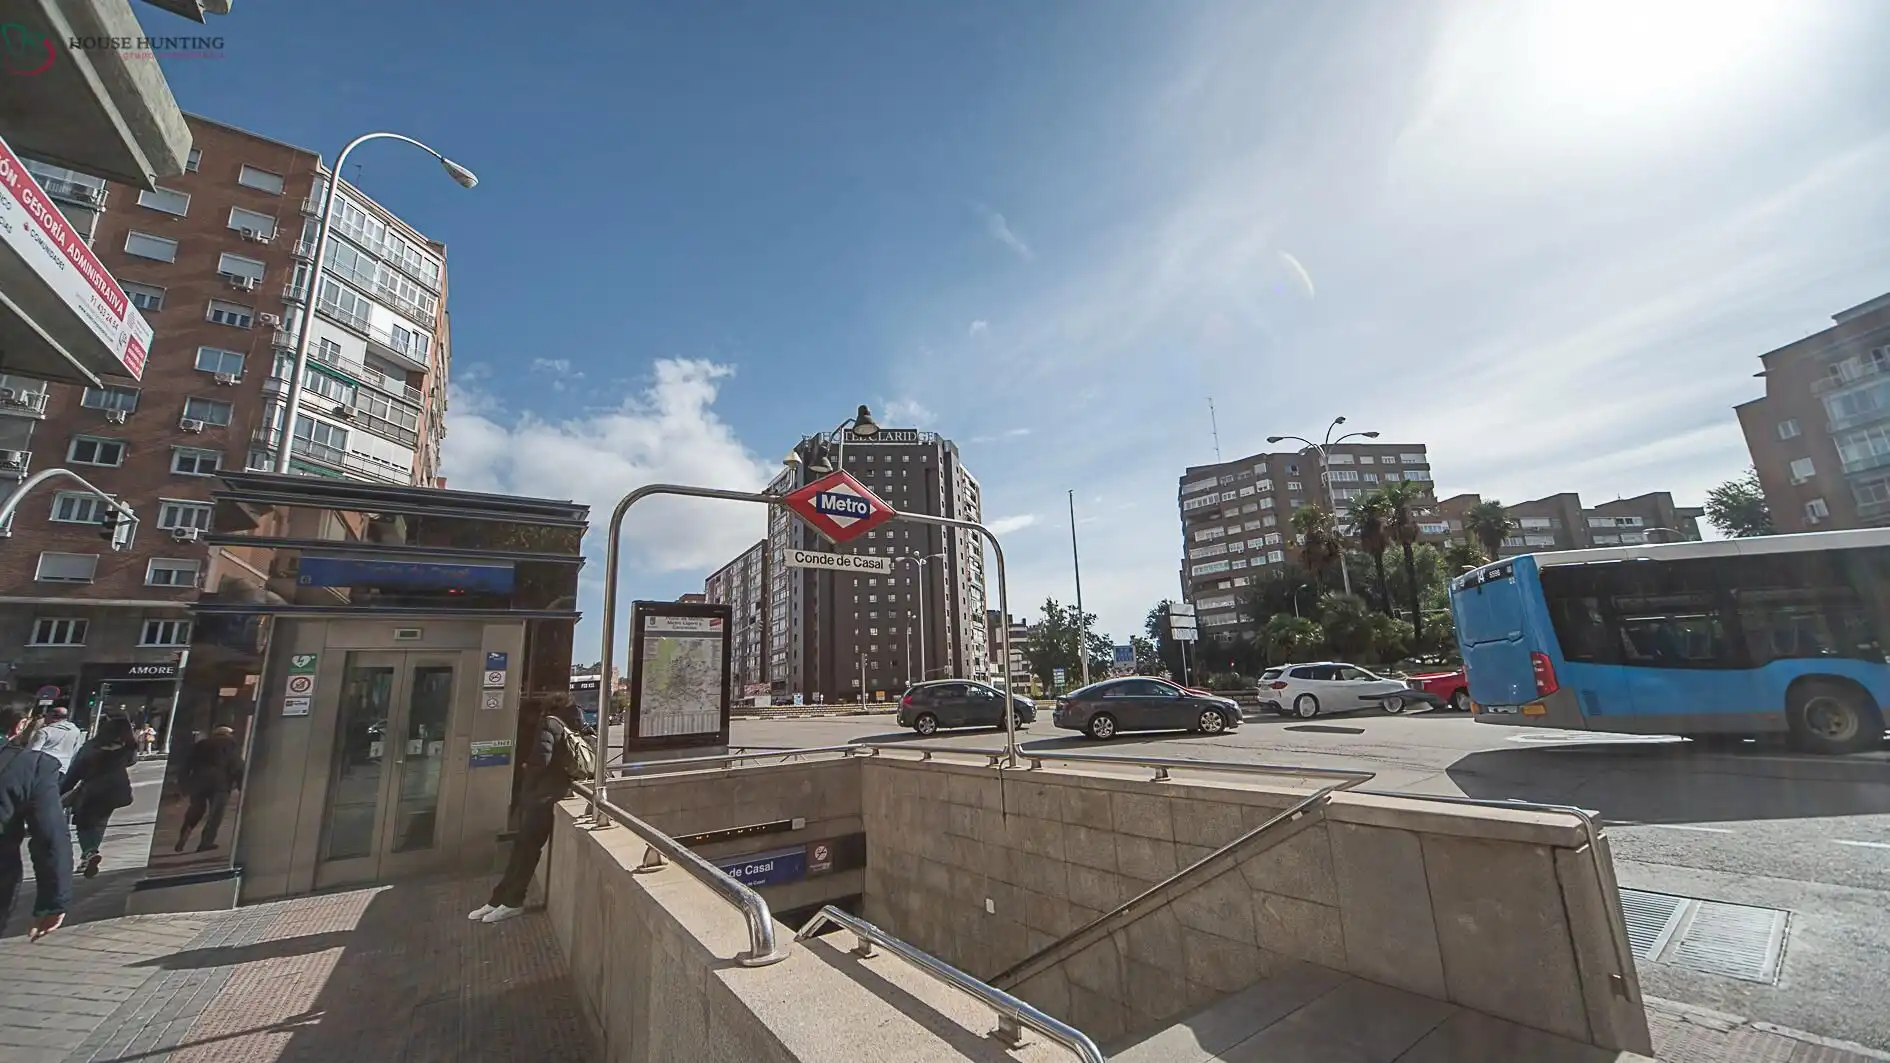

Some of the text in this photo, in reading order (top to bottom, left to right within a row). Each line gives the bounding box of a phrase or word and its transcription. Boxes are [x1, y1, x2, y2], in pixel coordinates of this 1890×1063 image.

[22, 188, 66, 247] GESTORÍA
[67, 242, 125, 317] ADMINISTRATIVA
[30, 228, 66, 272] COMUNIDADES
[821, 494, 868, 515] Metro
[795, 551, 884, 570] Conde de Casal
[729, 861, 774, 878] de Casal
